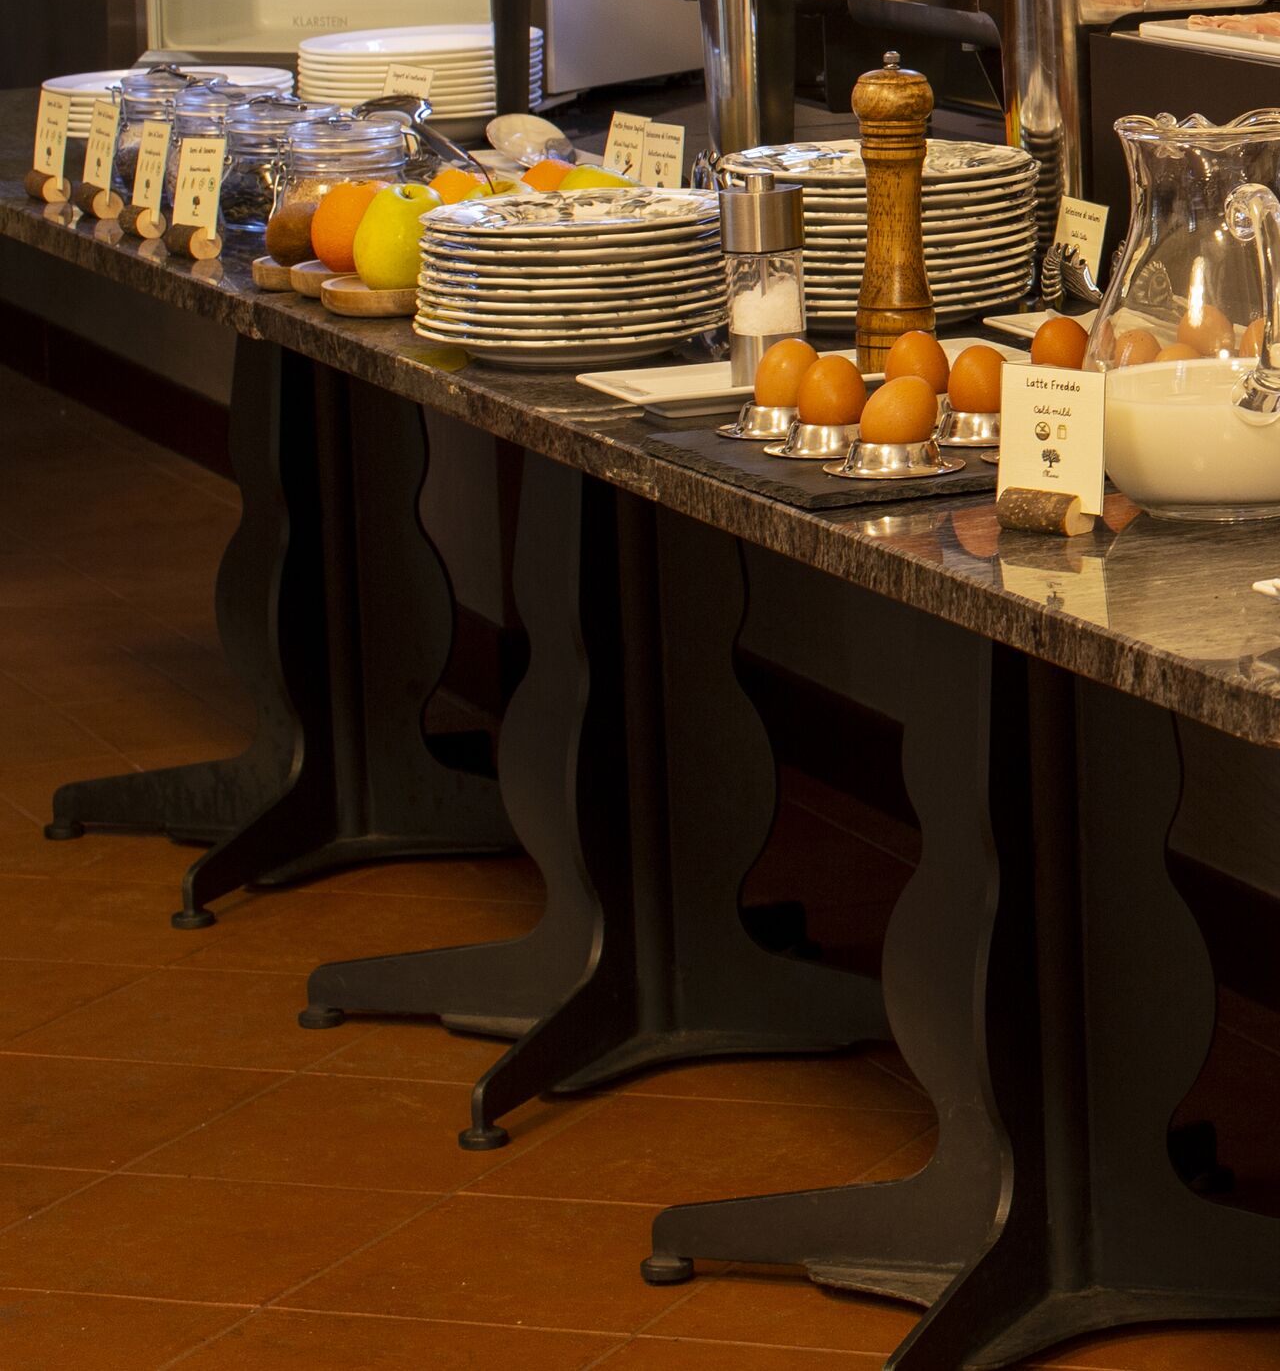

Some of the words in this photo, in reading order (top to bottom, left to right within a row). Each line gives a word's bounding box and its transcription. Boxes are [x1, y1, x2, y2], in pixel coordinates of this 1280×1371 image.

[292, 16, 349, 28] KLARSTEIN
[1026, 378, 1048, 390] Latte
[1051, 379, 1081, 392] Freddo
[1033, 405, 1051, 415] Cold
